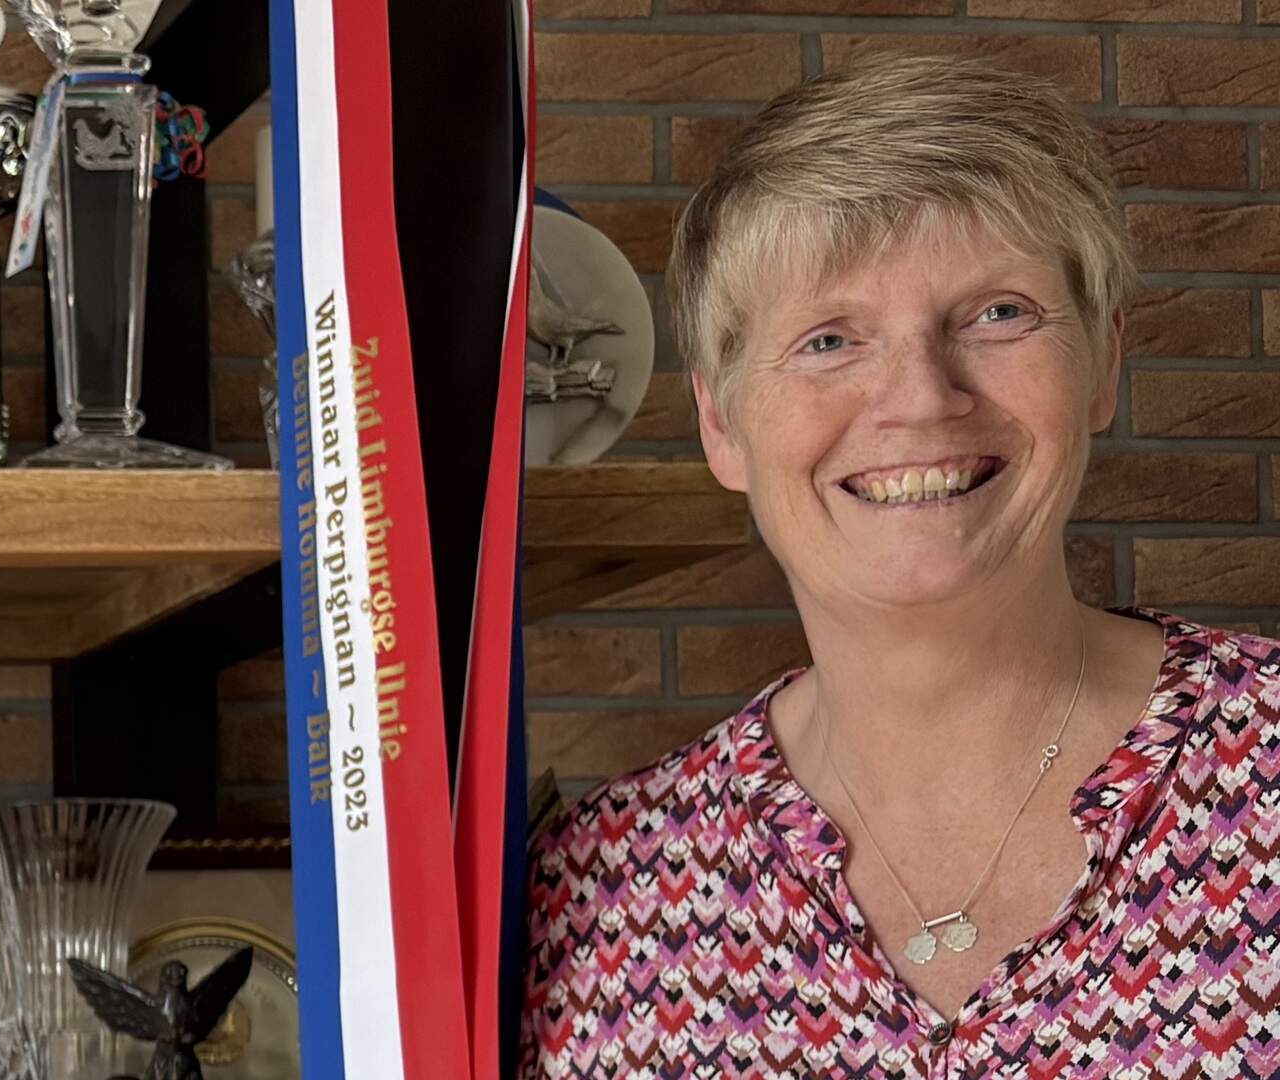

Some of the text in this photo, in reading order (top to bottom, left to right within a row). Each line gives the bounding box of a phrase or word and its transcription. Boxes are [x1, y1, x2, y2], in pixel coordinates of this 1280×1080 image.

[292, 351, 314, 491] Bennie
[315, 288, 341, 468] Winnaar
[298, 499, 319, 657] Homma
[323, 476, 357, 692] Perpignan
[349, 336, 408, 762] Zuid Limburgse Unie
[306, 709, 332, 805] Balk
[342, 746, 369, 832] 2023
